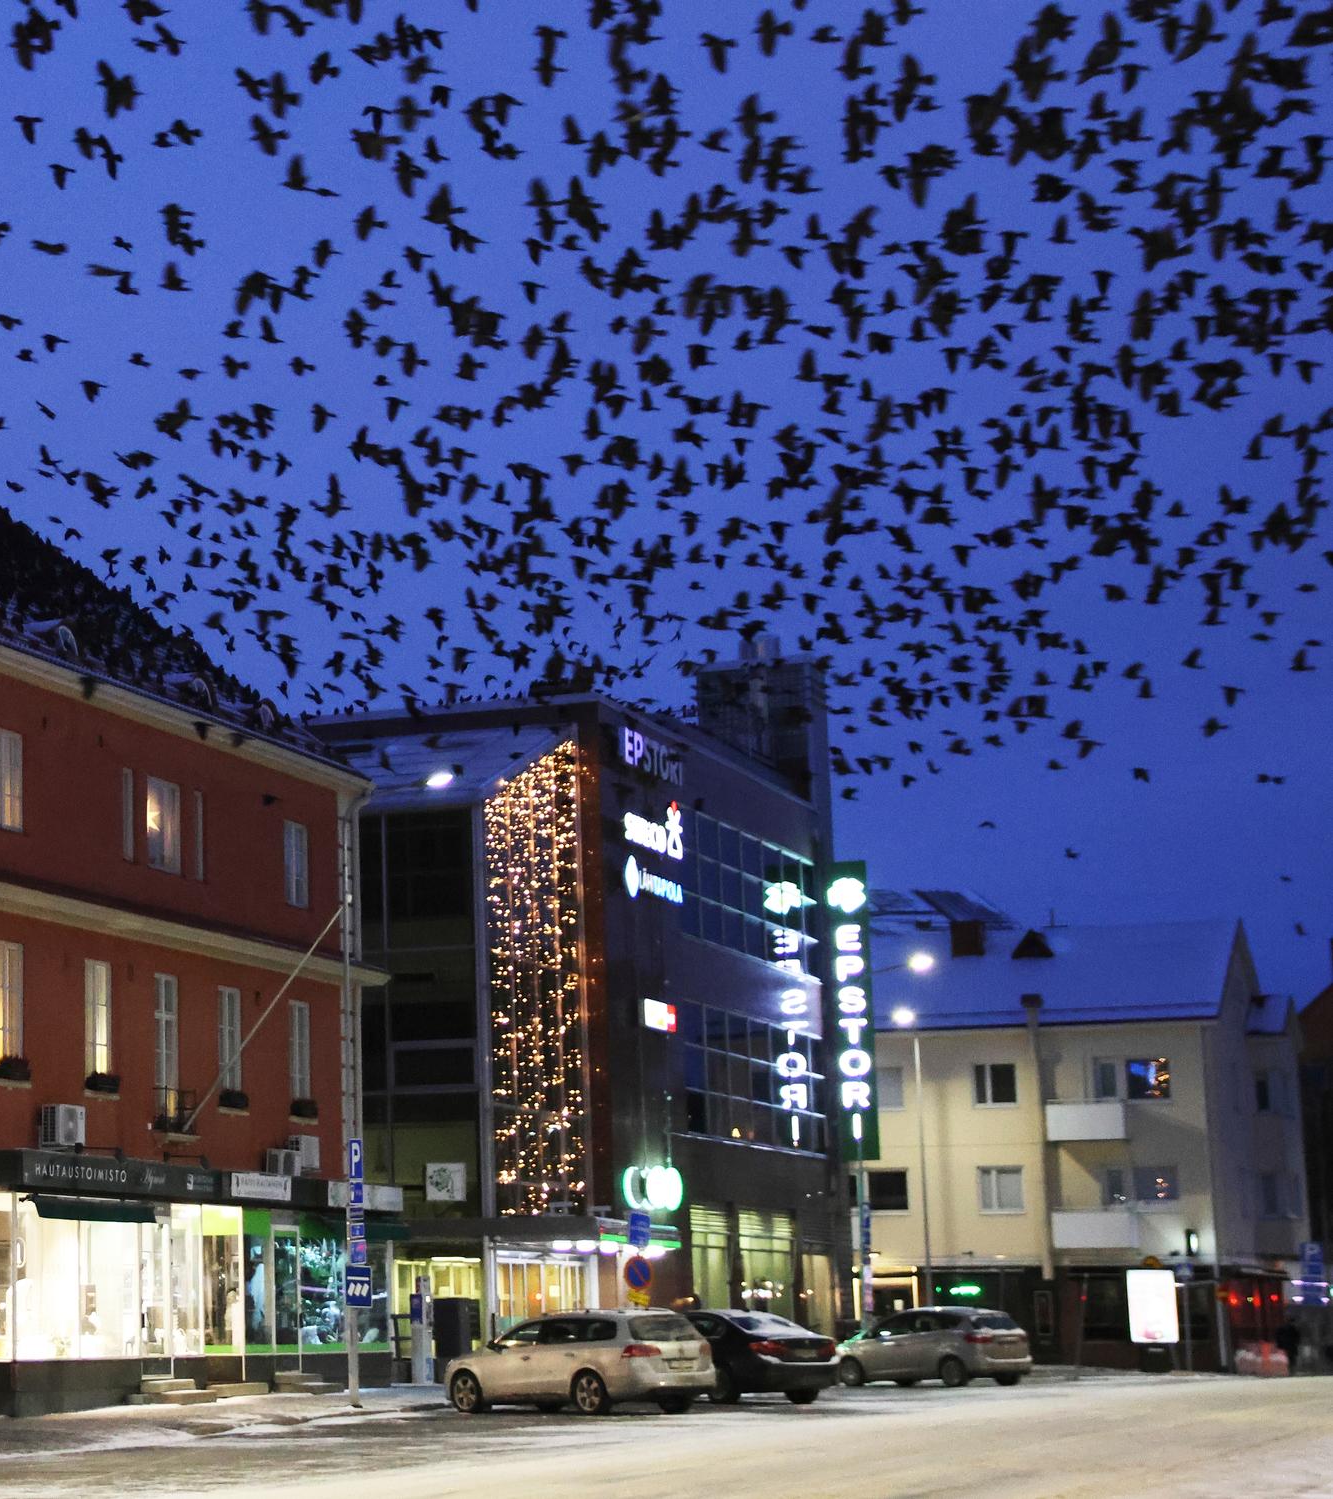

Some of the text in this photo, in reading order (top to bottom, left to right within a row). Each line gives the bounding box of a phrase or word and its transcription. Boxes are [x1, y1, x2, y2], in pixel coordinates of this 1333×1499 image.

[835, 923, 872, 1141] EPSTORI
[34, 1163, 128, 1183] HAUTAUSTOIMISTO
[351, 1142, 361, 1177] P
